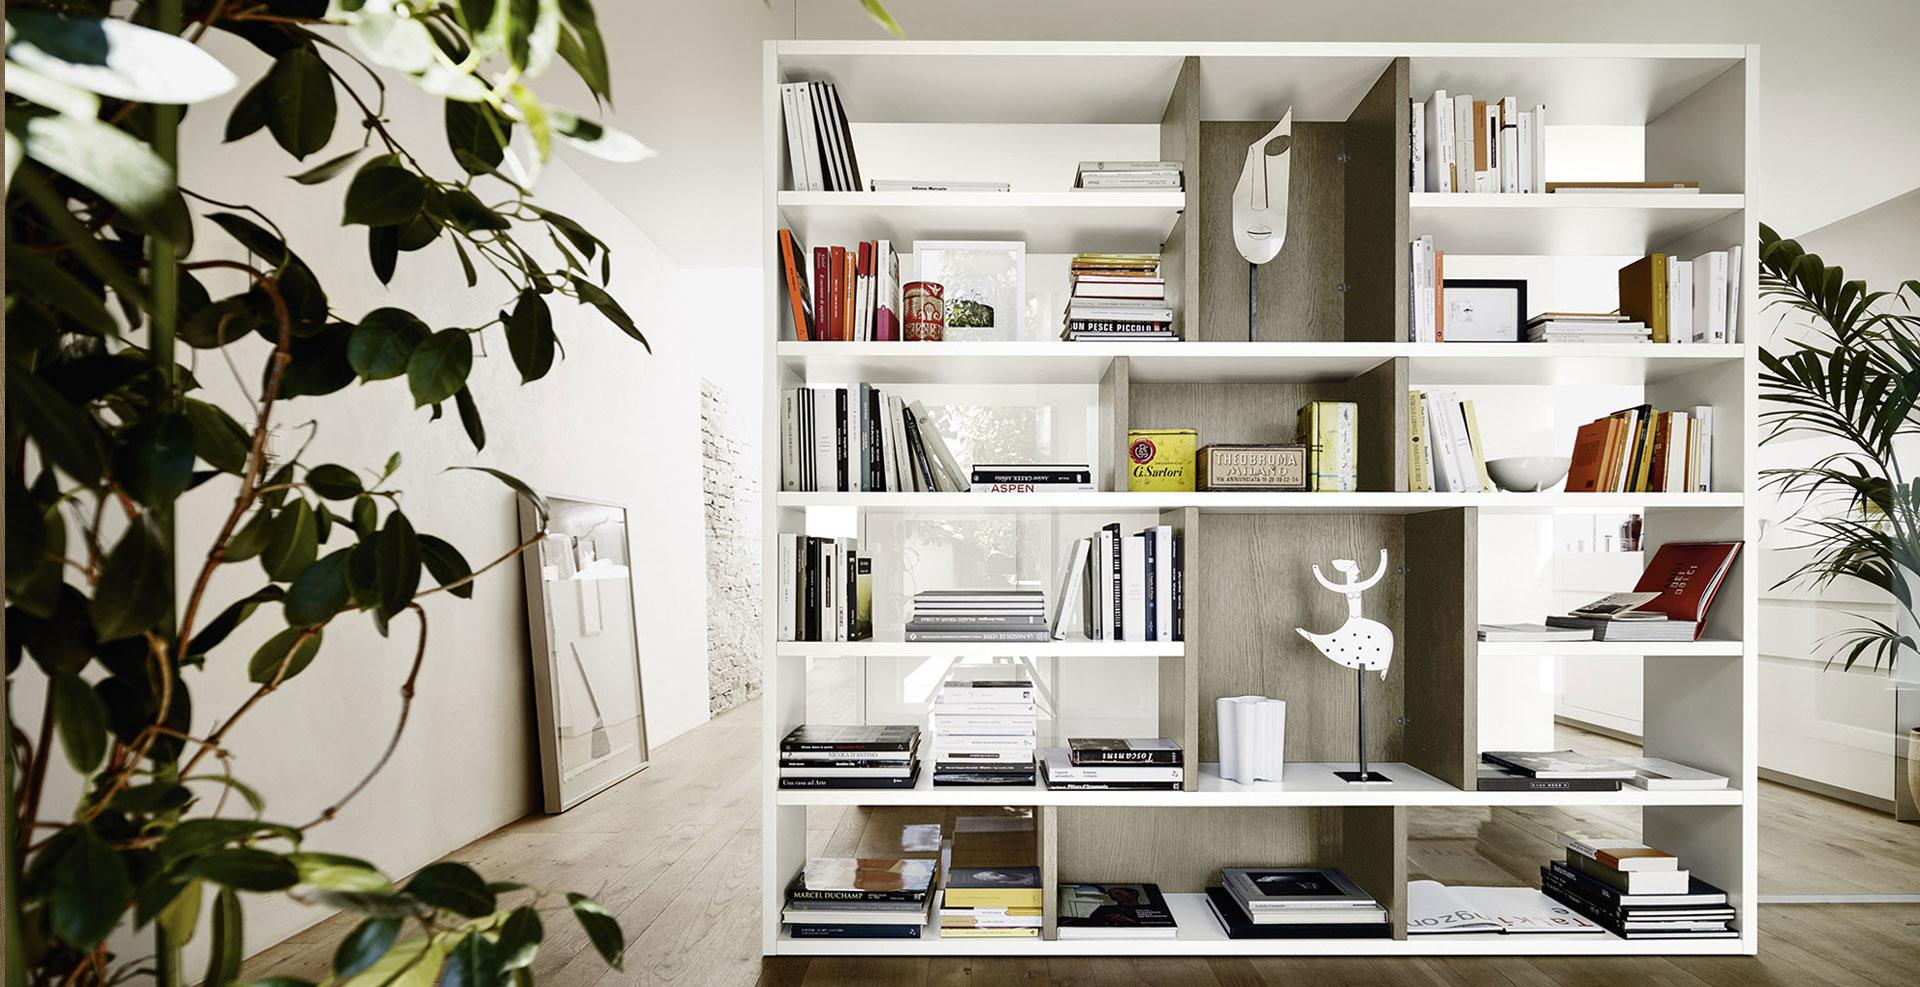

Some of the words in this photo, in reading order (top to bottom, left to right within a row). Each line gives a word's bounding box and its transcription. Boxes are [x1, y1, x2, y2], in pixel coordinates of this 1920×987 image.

[1073, 322, 1085, 331] UN
[1088, 322, 1113, 332] PESCE
[1216, 453, 1298, 466] THEOBROMA
[1227, 465, 1288, 476] MILANO
[991, 484, 1035, 493] ASPEN
[1102, 752, 1154, 763] Toscanini
[793, 892, 823, 900] MARCEL
[824, 892, 864, 900] DUCHAMP
